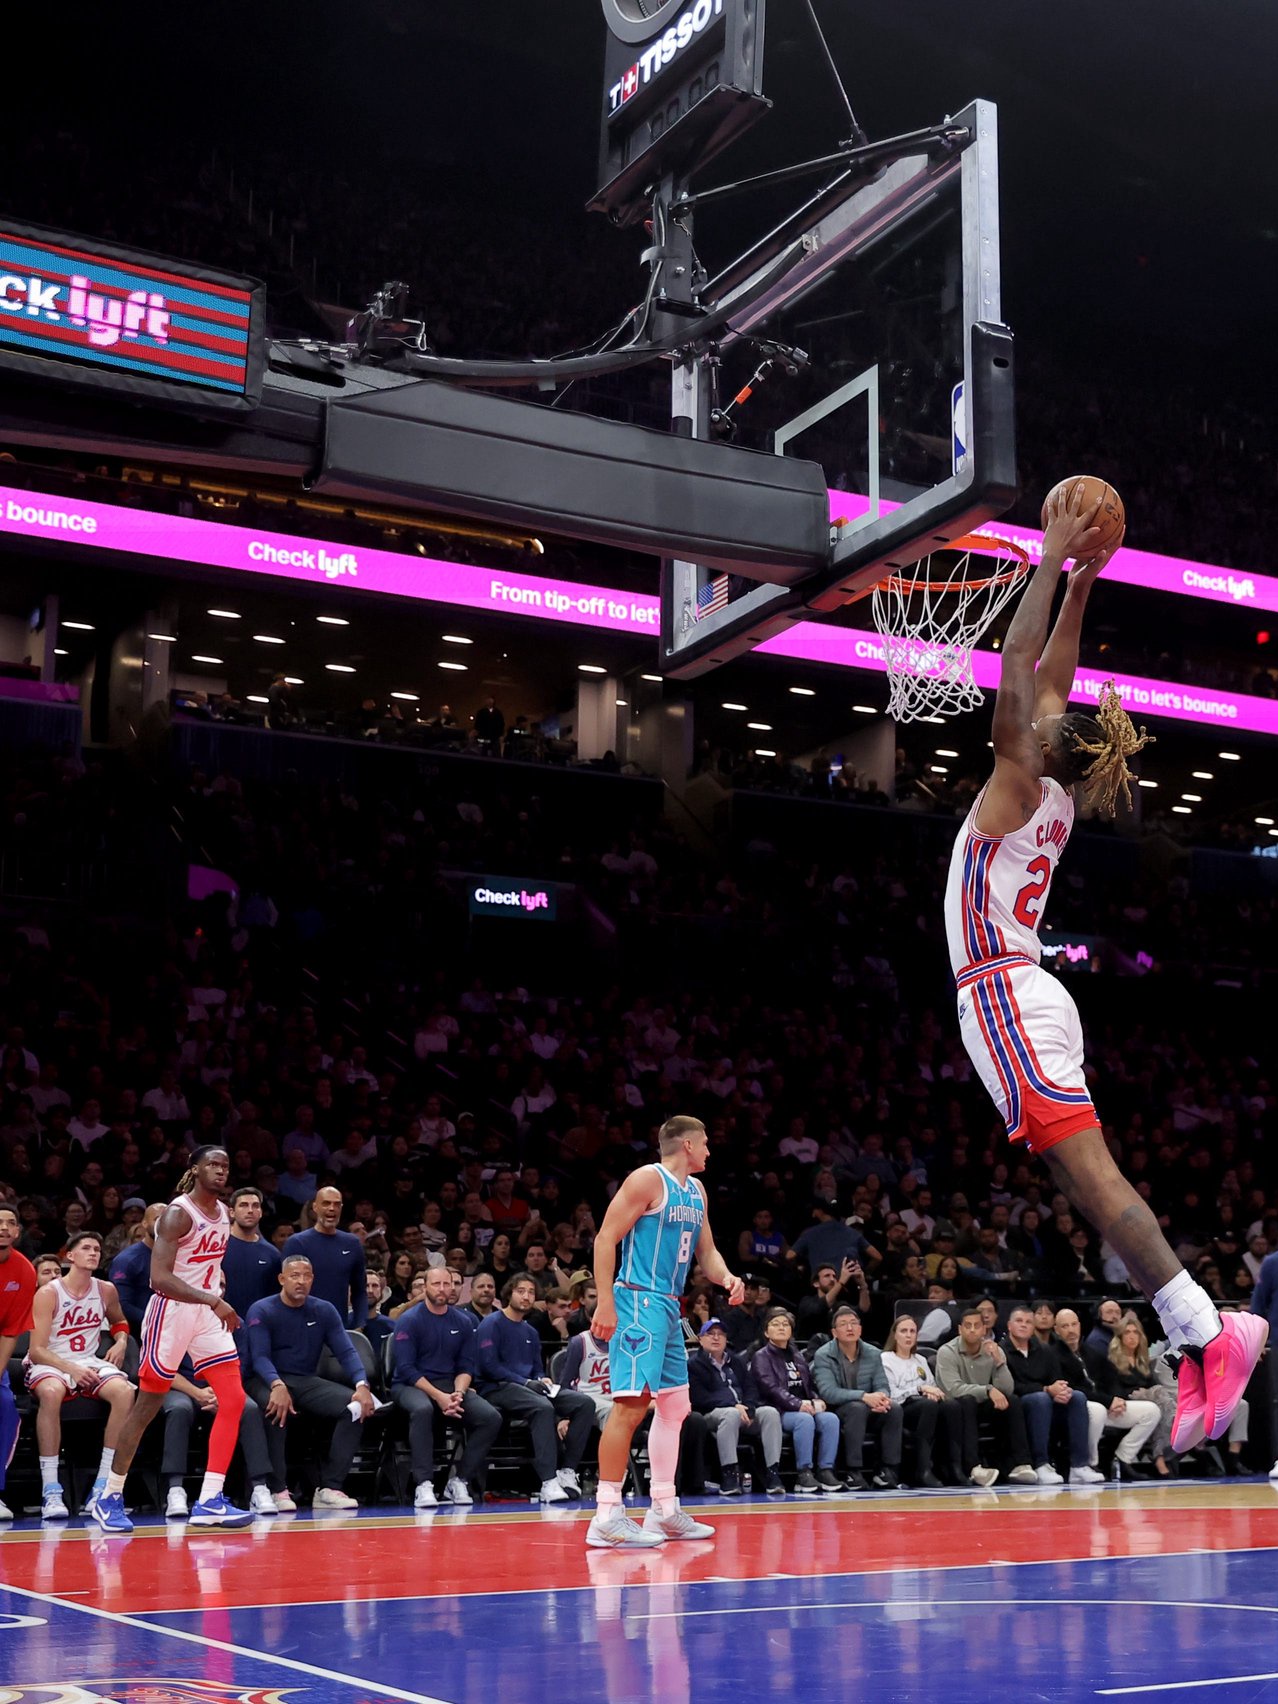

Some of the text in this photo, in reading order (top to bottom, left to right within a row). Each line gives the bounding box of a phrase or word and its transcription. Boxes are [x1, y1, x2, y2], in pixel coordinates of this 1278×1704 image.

[69, 274, 171, 346] lyft
[6, 501, 97, 534] bounce
[248, 541, 358, 578] Check lyft
[1183, 569, 1255, 600] Check lyft
[490, 581, 543, 606] From
[543, 589, 607, 615] tip-off
[608, 600, 629, 619] to
[630, 604, 661, 625] let'
[1133, 685, 1150, 705] to
[1150, 690, 1182, 710] let's
[1183, 695, 1238, 719] bounce
[475, 888, 549, 911] Check lyft
[1013, 854, 1051, 930] 2
[1065, 943, 1088, 963] lyft
[678, 1230, 693, 1264] 8
[202, 1264, 215, 1290] 1
[60, 1306, 101, 1329] Nets
[69, 1334, 87, 1353] 8
